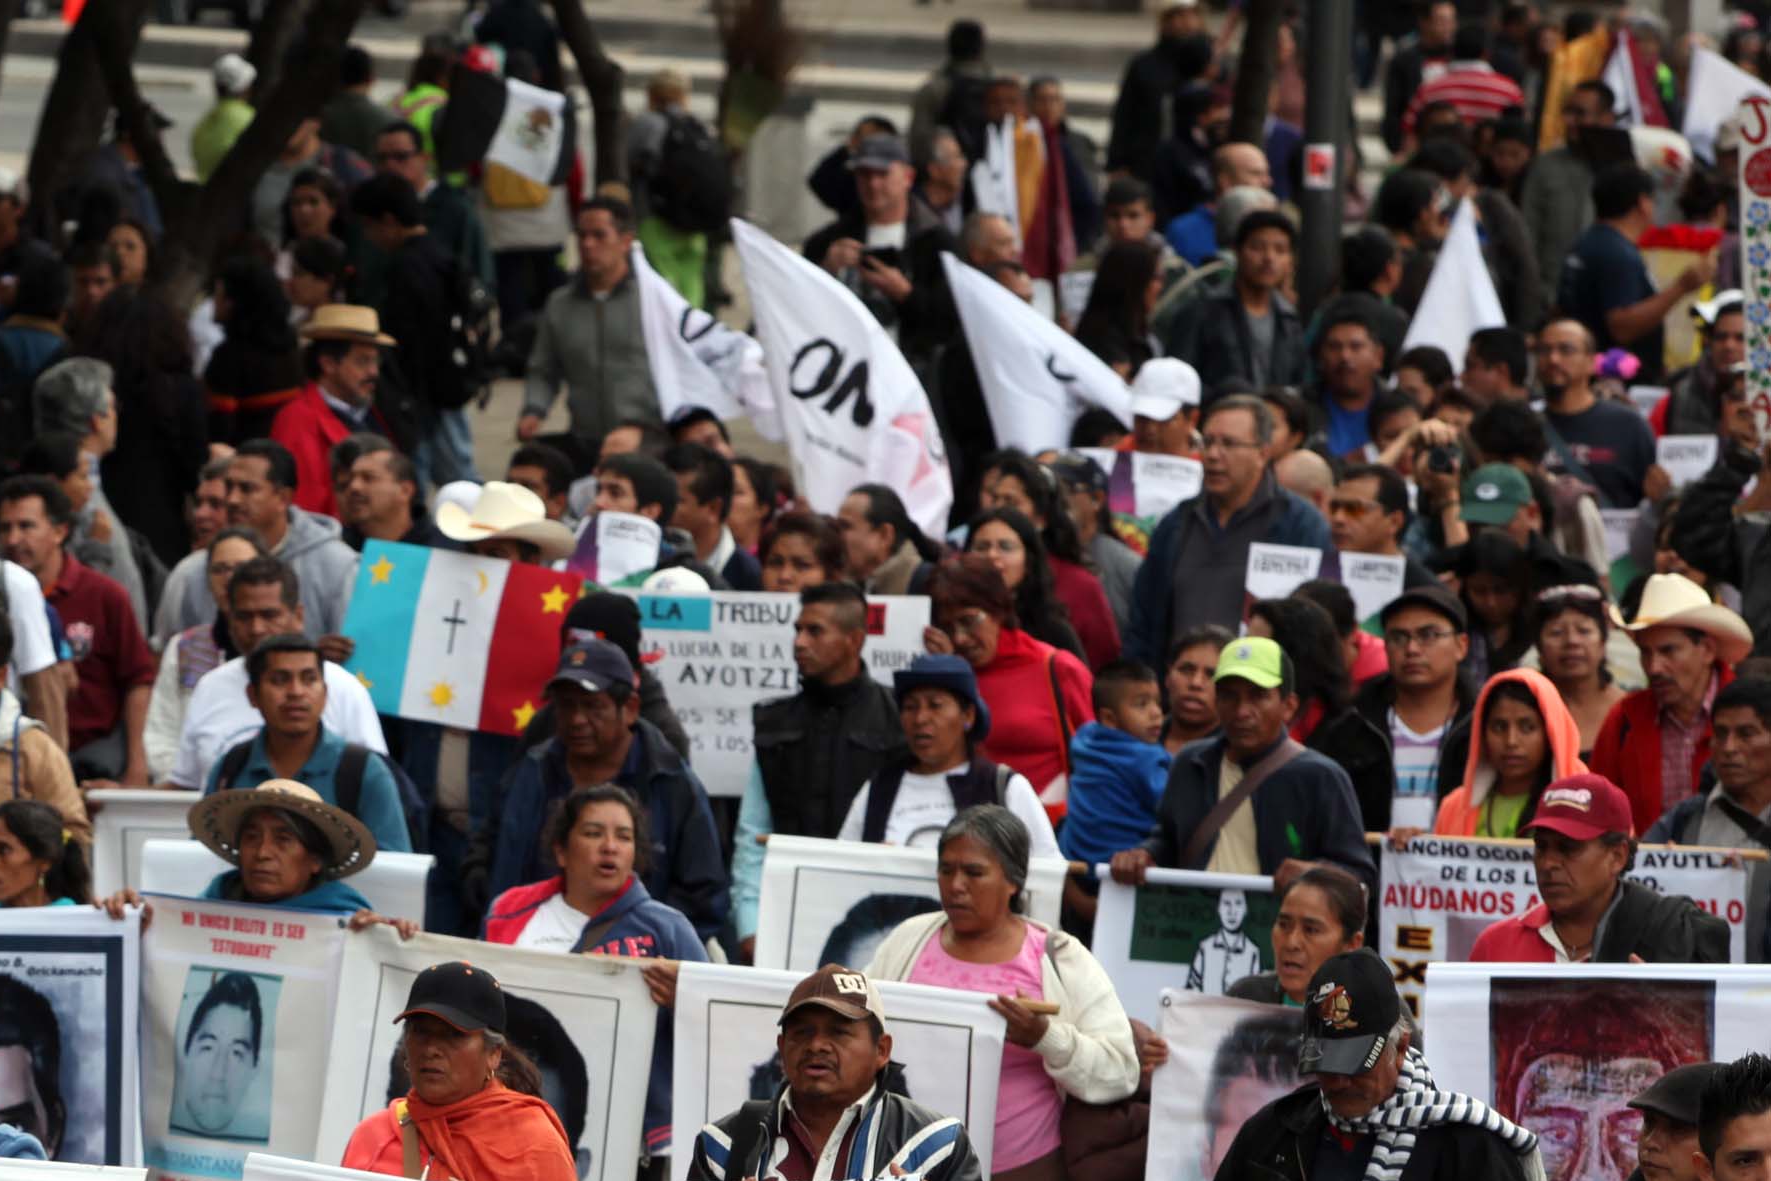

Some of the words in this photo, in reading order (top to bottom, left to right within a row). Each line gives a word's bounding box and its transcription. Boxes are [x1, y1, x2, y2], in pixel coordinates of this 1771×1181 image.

[650, 600, 683, 621] LA
[669, 640, 723, 657] LUCHA
[730, 642, 750, 658] DE
[759, 644, 784, 660] LA
[1441, 866, 1468, 881] DE
[1475, 869, 1516, 885] LOS
[1384, 879, 1515, 916] AYÚDANOS
[1364, 1036, 1386, 1069] VAQUERO
